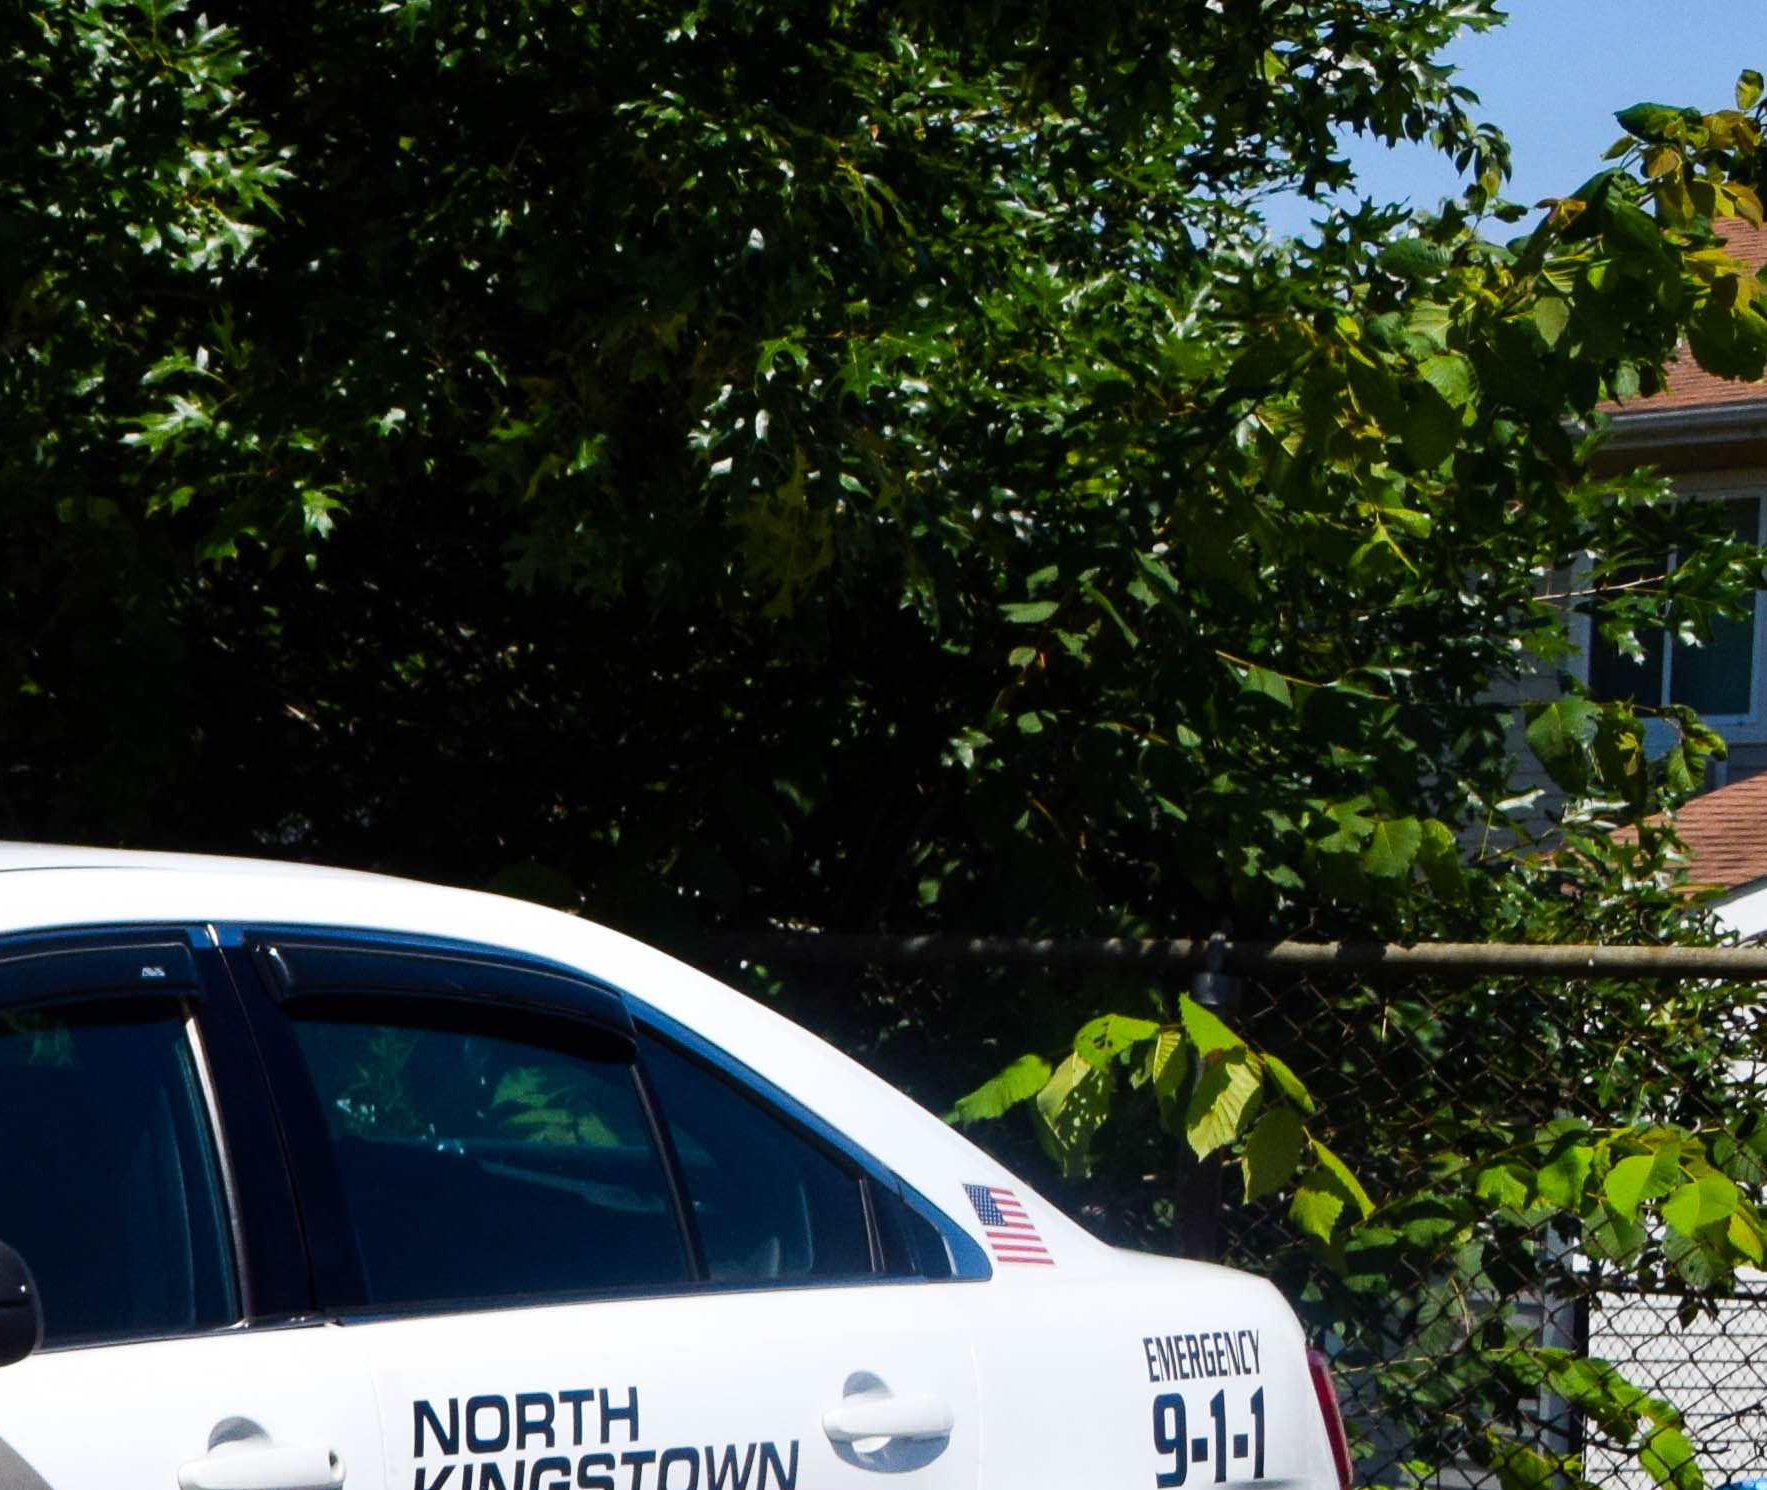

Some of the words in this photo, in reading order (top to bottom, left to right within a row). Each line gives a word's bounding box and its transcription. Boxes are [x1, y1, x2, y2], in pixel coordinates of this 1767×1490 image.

[1143, 1329, 1259, 1382] EMERGENCY
[413, 1386, 639, 1458] NORTH
[1153, 1386, 1264, 1489] 9-1-1
